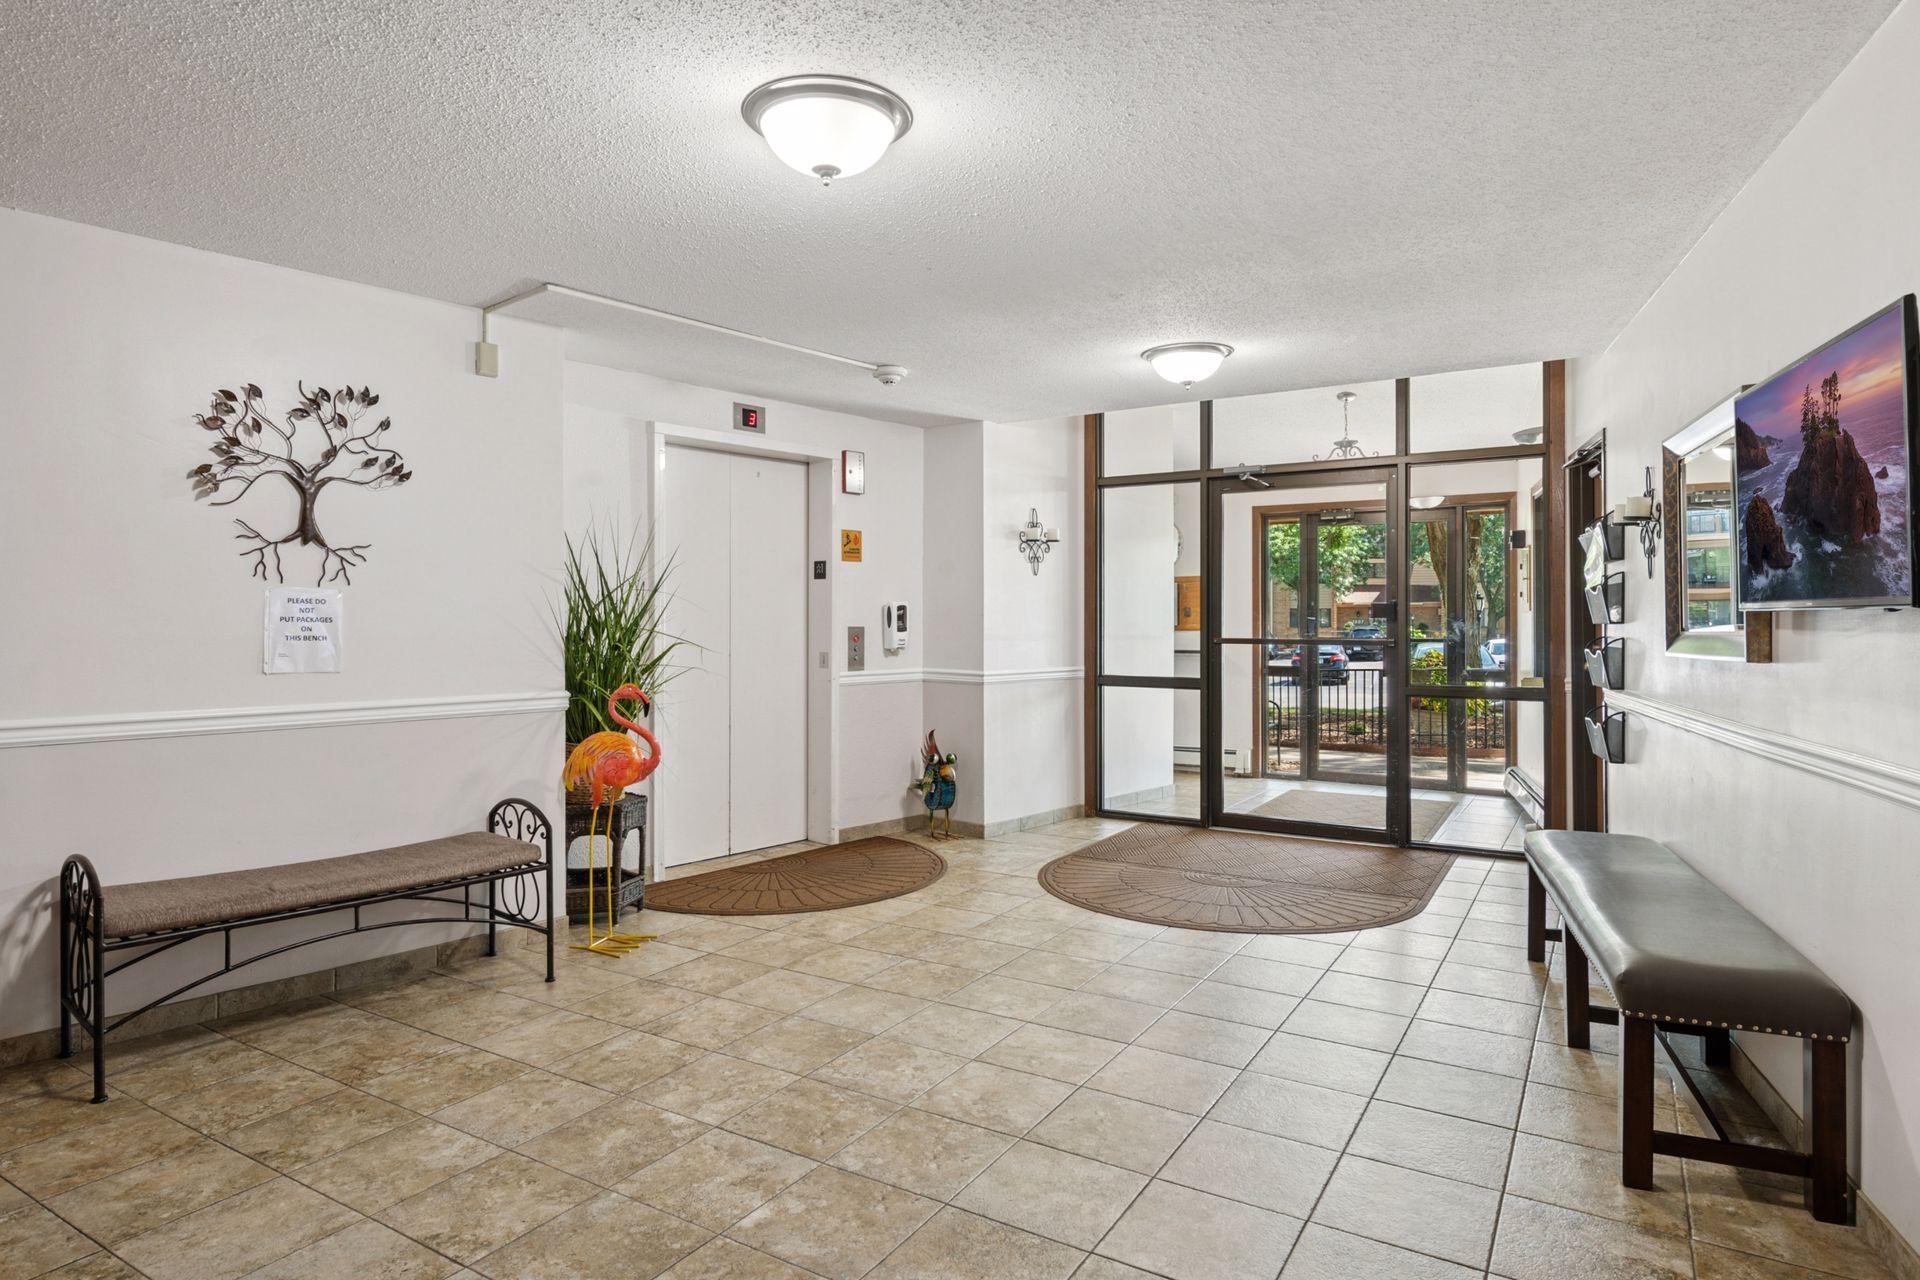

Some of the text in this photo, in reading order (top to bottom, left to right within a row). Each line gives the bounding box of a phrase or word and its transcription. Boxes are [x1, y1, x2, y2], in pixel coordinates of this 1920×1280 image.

[749, 413, 756, 425] 3
[287, 597, 313, 605] PLEASE
[296, 616, 333, 624] PACKAGES
[300, 625, 312, 633] ON
[303, 634, 327, 642] BENCH
